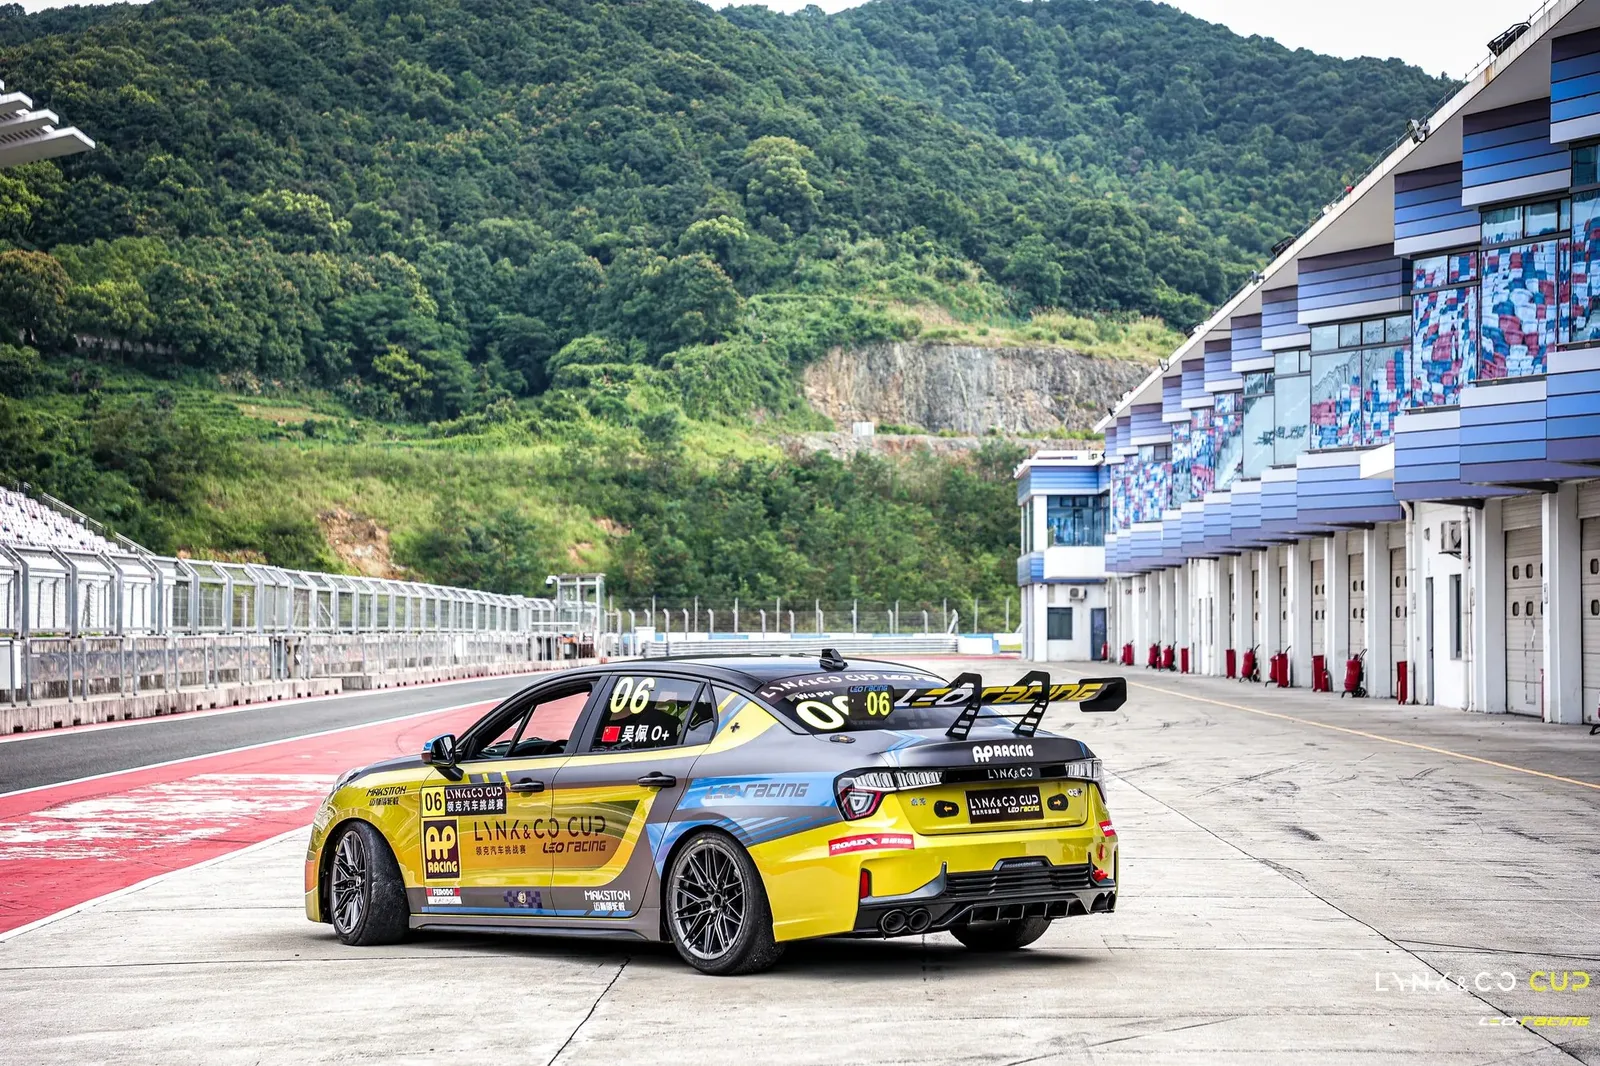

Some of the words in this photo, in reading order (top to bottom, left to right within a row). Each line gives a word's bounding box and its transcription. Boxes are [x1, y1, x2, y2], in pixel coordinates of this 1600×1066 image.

[610, 676, 655, 714] 06
[868, 691, 890, 716] 06
[621, 724, 649, 742] 吴佩
[425, 792, 442, 811] 06
[445, 788, 484, 800] LYNK&CO
[485, 787, 503, 798] CUP
[969, 795, 1017, 809] LYNK&CO
[1019, 794, 1039, 805] CUP
[474, 818, 559, 841] LYNK&CO
[567, 815, 606, 837] CUP
[426, 826, 456, 861] AP
[542, 842, 565, 853] LEO
[566, 841, 607, 853] racing
[428, 861, 458, 873] RACING
